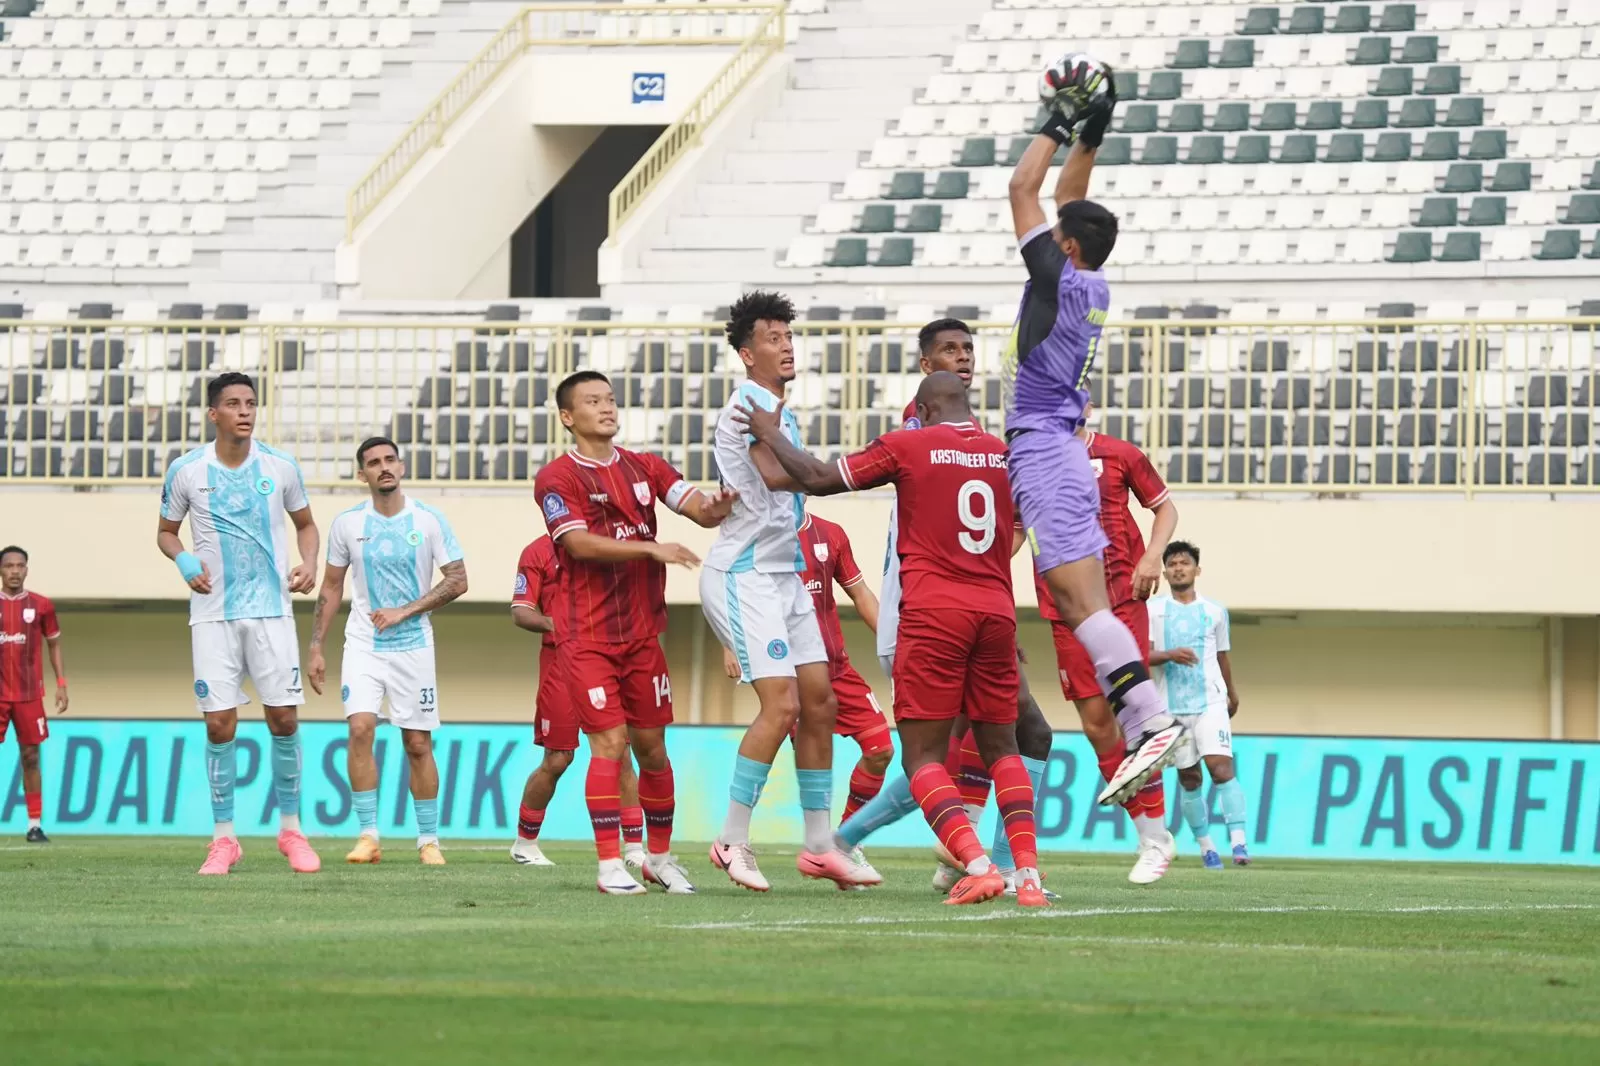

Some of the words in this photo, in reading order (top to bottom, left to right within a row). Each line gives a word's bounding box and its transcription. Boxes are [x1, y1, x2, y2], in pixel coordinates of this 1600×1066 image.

[633, 76, 664, 97] C2
[930, 449, 987, 468] KASTANEER
[957, 480, 996, 555] 9
[292, 667, 299, 687] 7
[419, 687, 434, 705] 33
[652, 673, 672, 708] 14
[1218, 730, 1230, 744] 94
[1311, 754, 1600, 854] PASIFI
